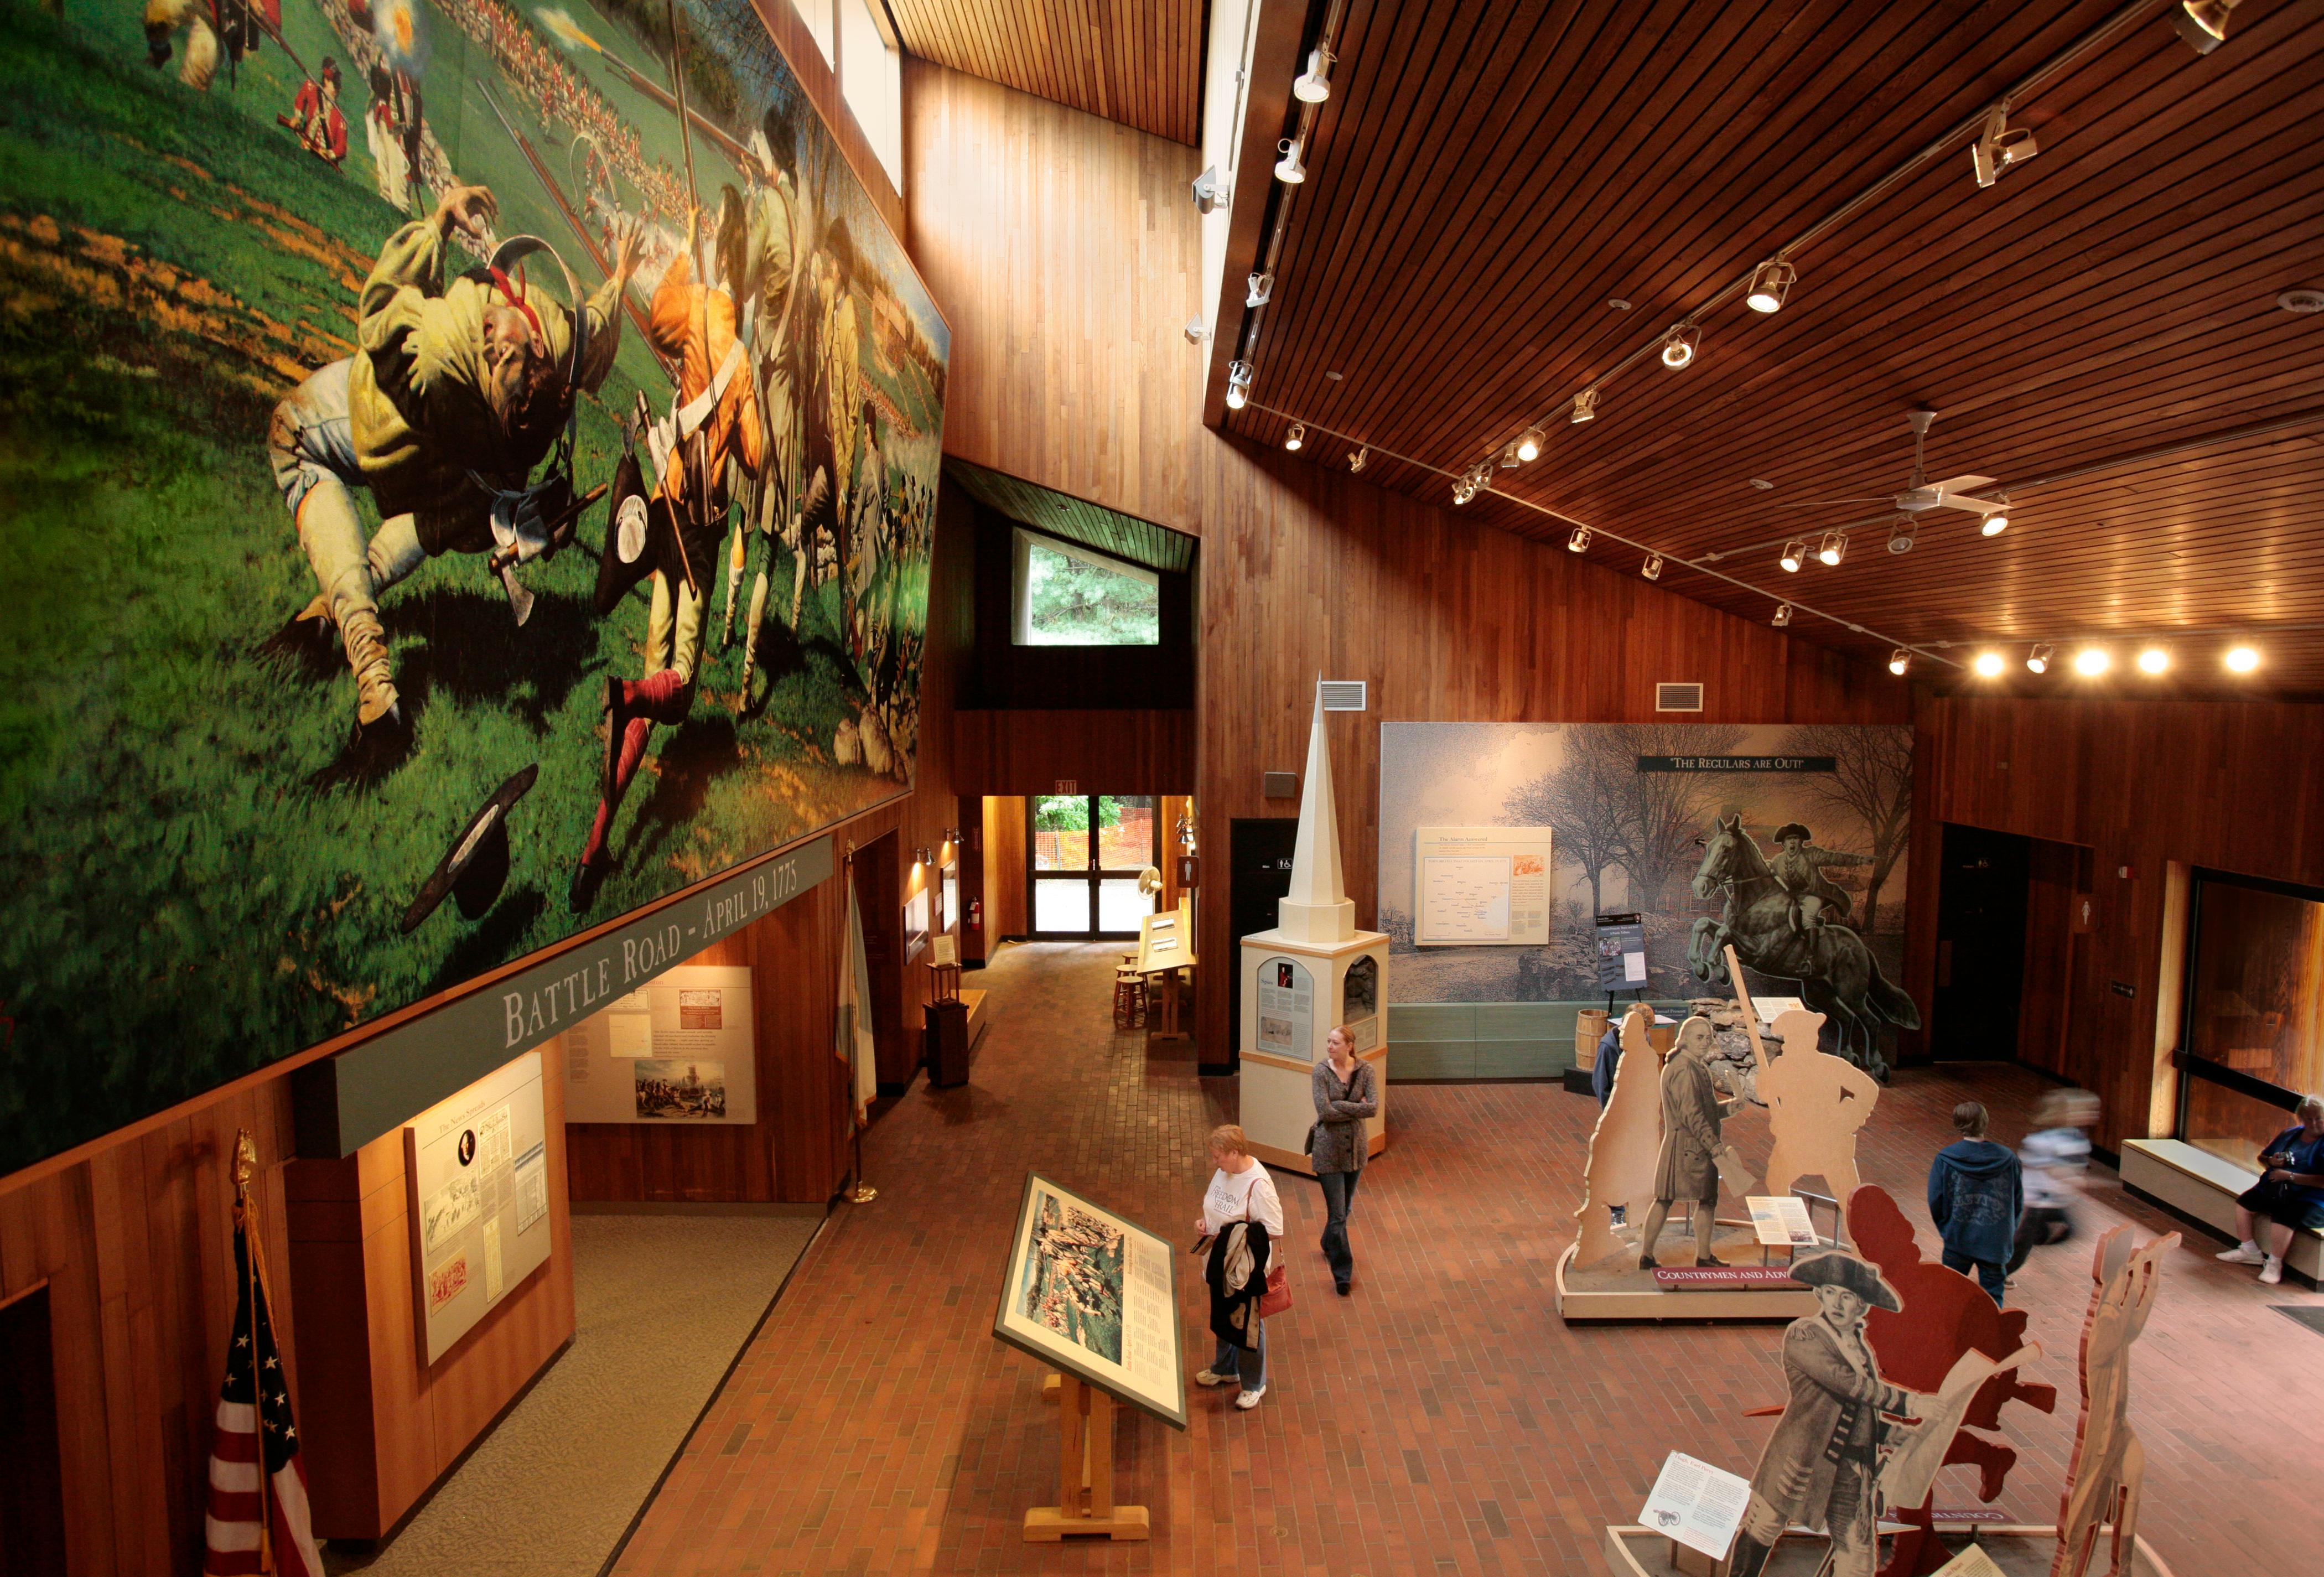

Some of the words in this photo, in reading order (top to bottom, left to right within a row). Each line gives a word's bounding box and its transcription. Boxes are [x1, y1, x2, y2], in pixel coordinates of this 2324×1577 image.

[1699, 758, 1751, 769] REGULARS
[1753, 759, 1771, 769] ARE
[1056, 781, 1076, 794] EXIT
[504, 958, 610, 1049] BATTLE
[622, 925, 681, 984] ROAD
[703, 891, 748, 938] APRIL
[753, 875, 769, 912] 19,
[772, 859, 797, 901] 1775
[439, 1124, 449, 1134] The
[466, 1100, 485, 1117] Spreads
[1211, 1185, 1240, 1206] FREEDOM
[1215, 1200, 1234, 1215] TRAIL
[1657, 1270, 1737, 1279] COUNTRYMEN
[1765, 1270, 1787, 1279] ADV
